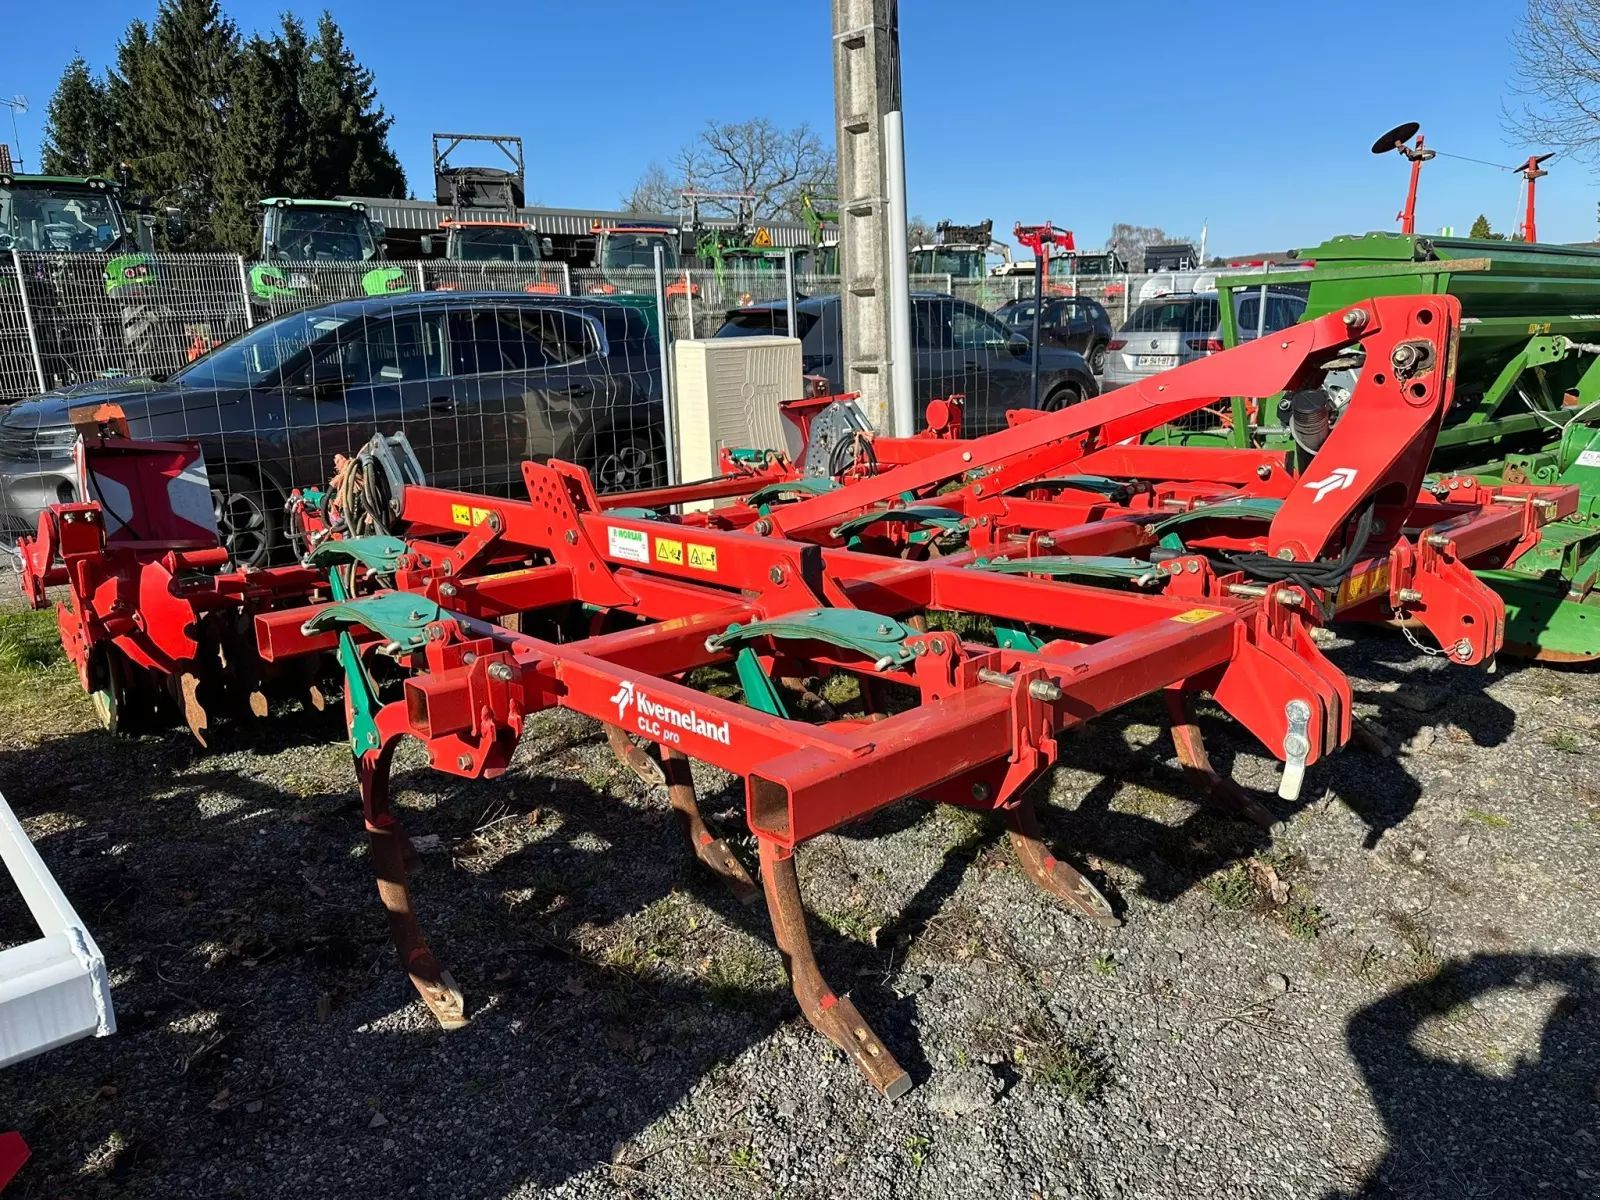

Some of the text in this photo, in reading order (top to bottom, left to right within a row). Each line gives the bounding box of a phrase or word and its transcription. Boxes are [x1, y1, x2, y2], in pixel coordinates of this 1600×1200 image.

[636, 690, 731, 746] Kverneland
[637, 716, 680, 745] CLC pro
